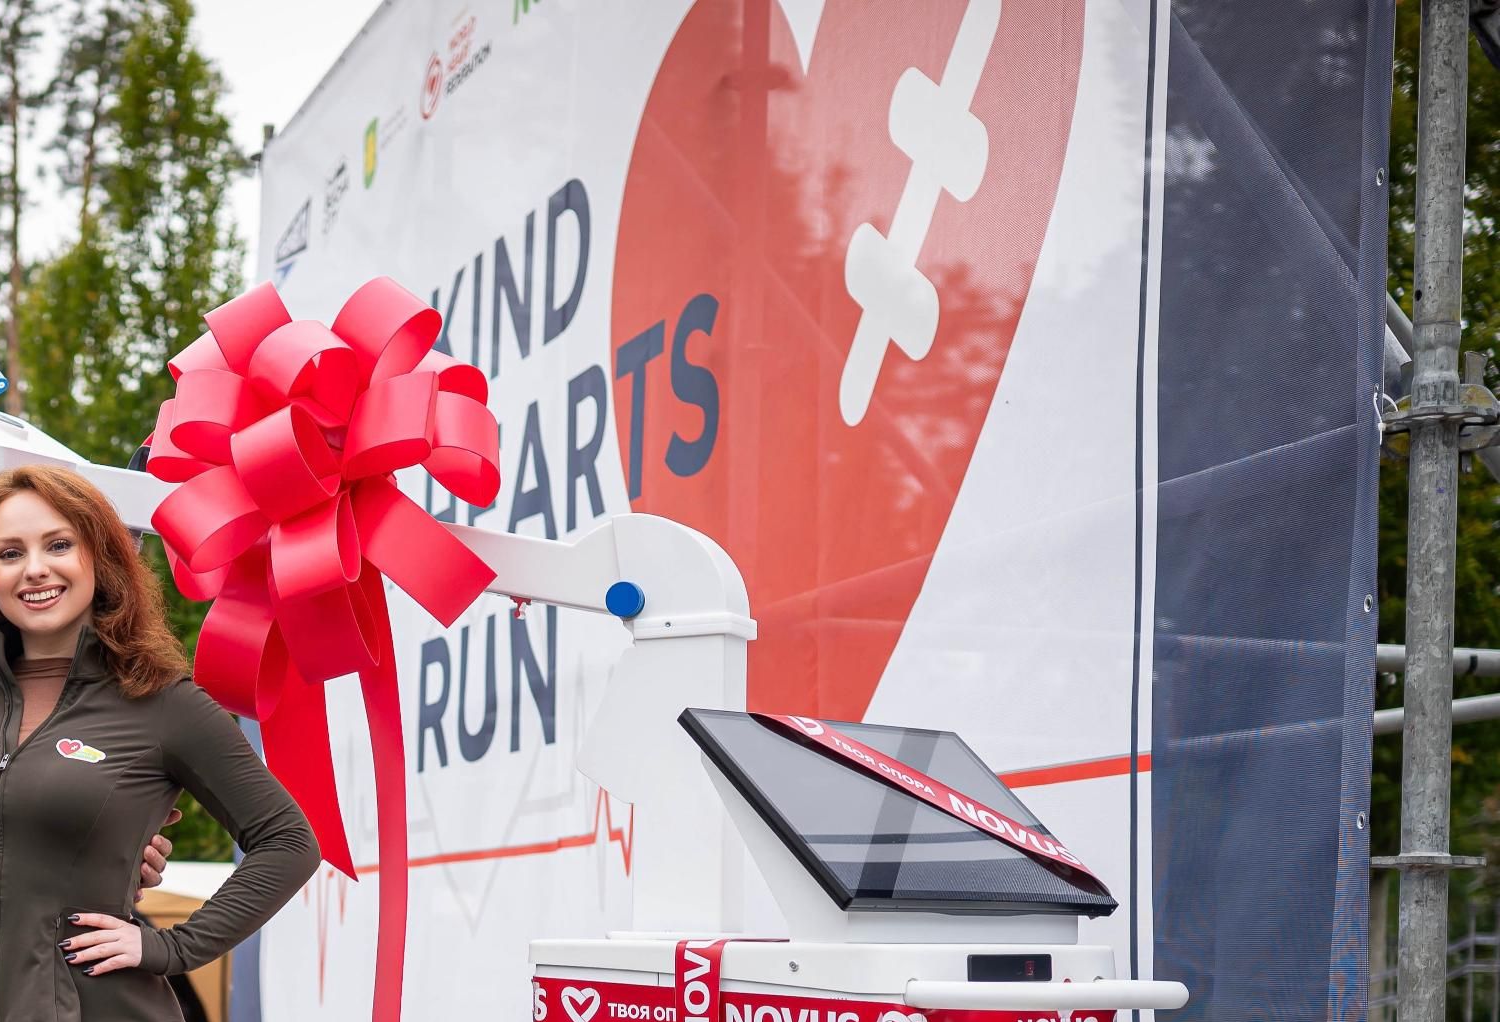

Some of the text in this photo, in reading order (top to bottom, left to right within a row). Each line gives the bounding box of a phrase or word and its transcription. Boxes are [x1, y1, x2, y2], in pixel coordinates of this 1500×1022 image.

[430, 178, 591, 380] KIND
[424, 292, 721, 541] ARTS
[417, 603, 558, 774] RUN
[830, 736, 1083, 866] ТВОЯ ОПОРА NOVUS
[607, 1002, 650, 1020] ТВОЯ
